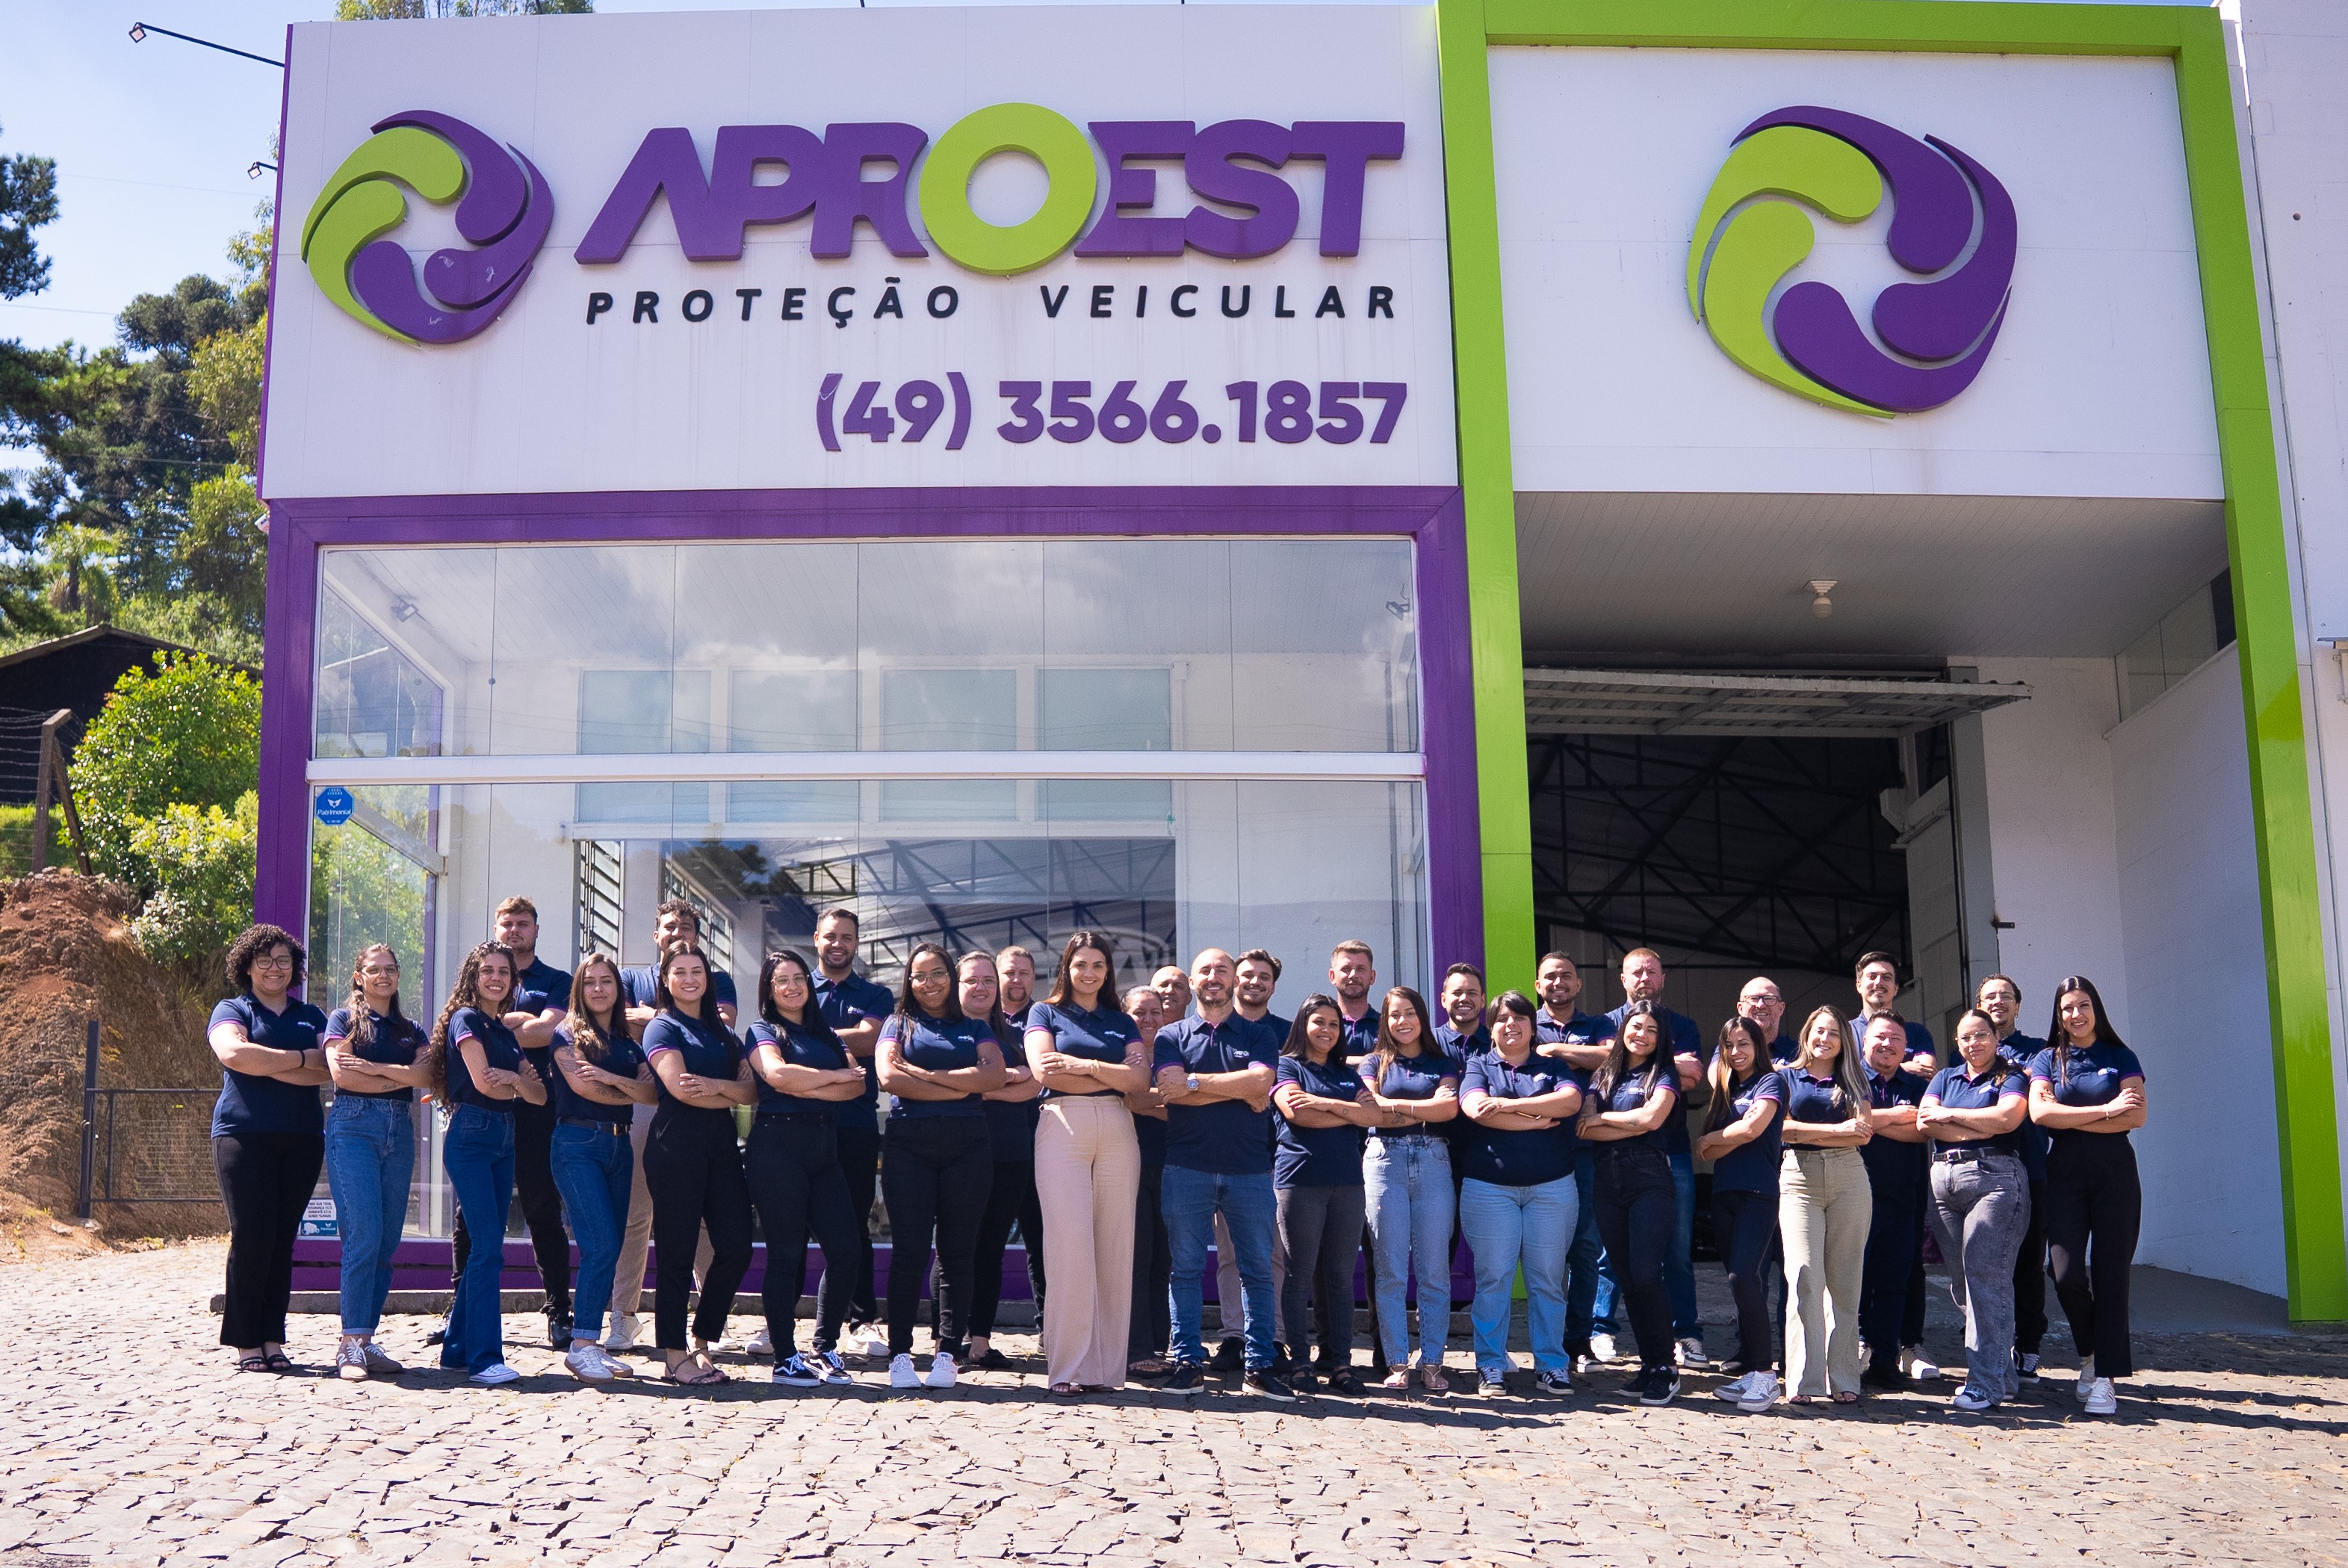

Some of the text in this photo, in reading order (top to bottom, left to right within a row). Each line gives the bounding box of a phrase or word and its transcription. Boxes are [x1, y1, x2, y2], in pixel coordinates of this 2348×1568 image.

[574, 103, 1405, 275] APROEST
[586, 276, 1396, 327] PROTEÇÃO VEICULAR
[817, 372, 1407, 450] (49) 3566.1857
